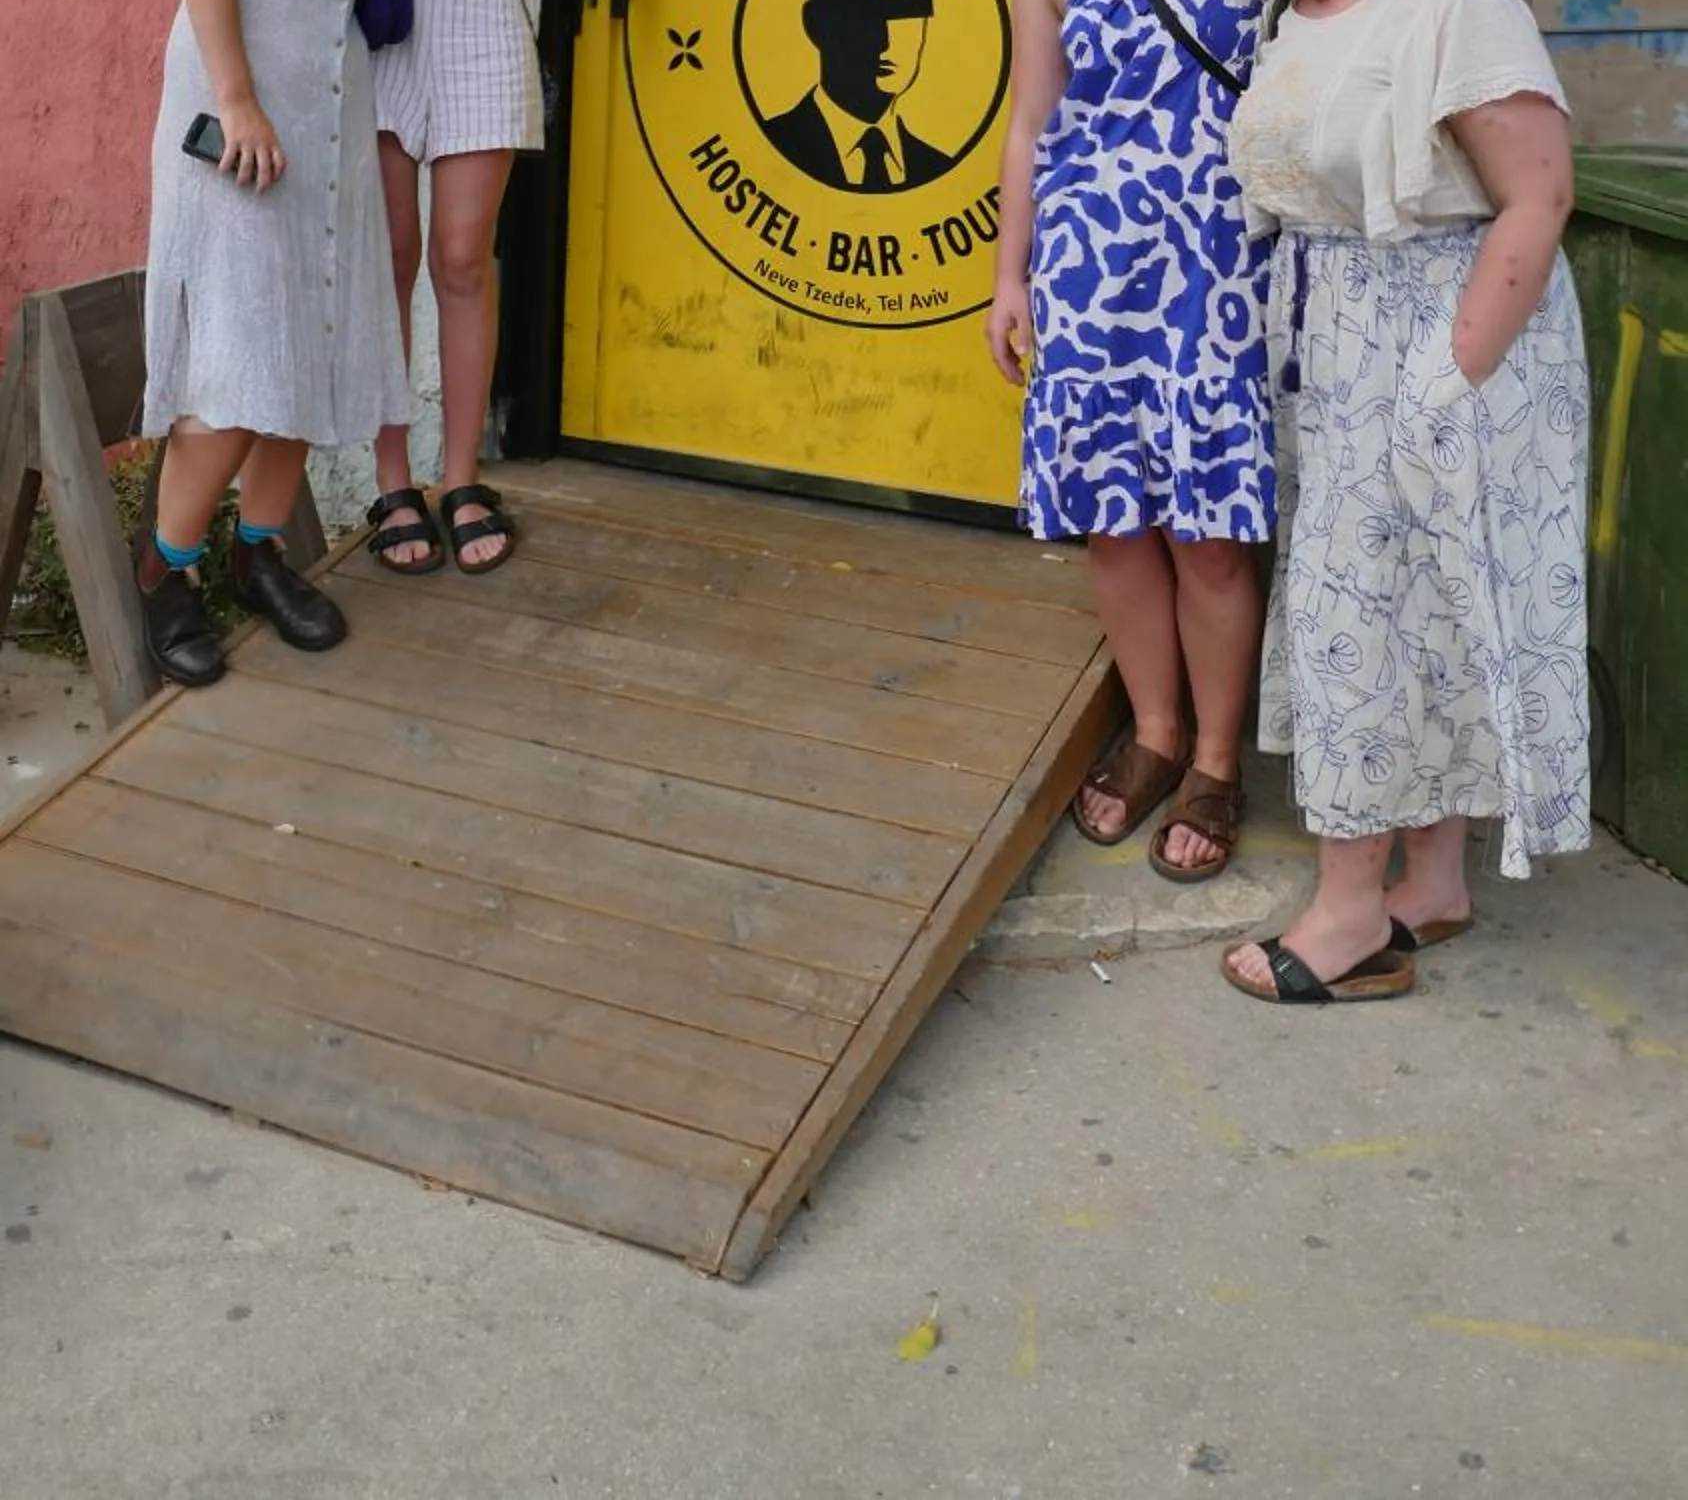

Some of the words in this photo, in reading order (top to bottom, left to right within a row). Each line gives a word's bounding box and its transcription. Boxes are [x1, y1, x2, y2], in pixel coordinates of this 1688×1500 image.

[688, 133, 800, 258] HOSTEL
[827, 231, 904, 277] BAR
[753, 258, 800, 293] Neve
[803, 280, 872, 315] Tzedek,
[876, 294, 903, 312] Tel
[909, 288, 949, 311] Aviv
